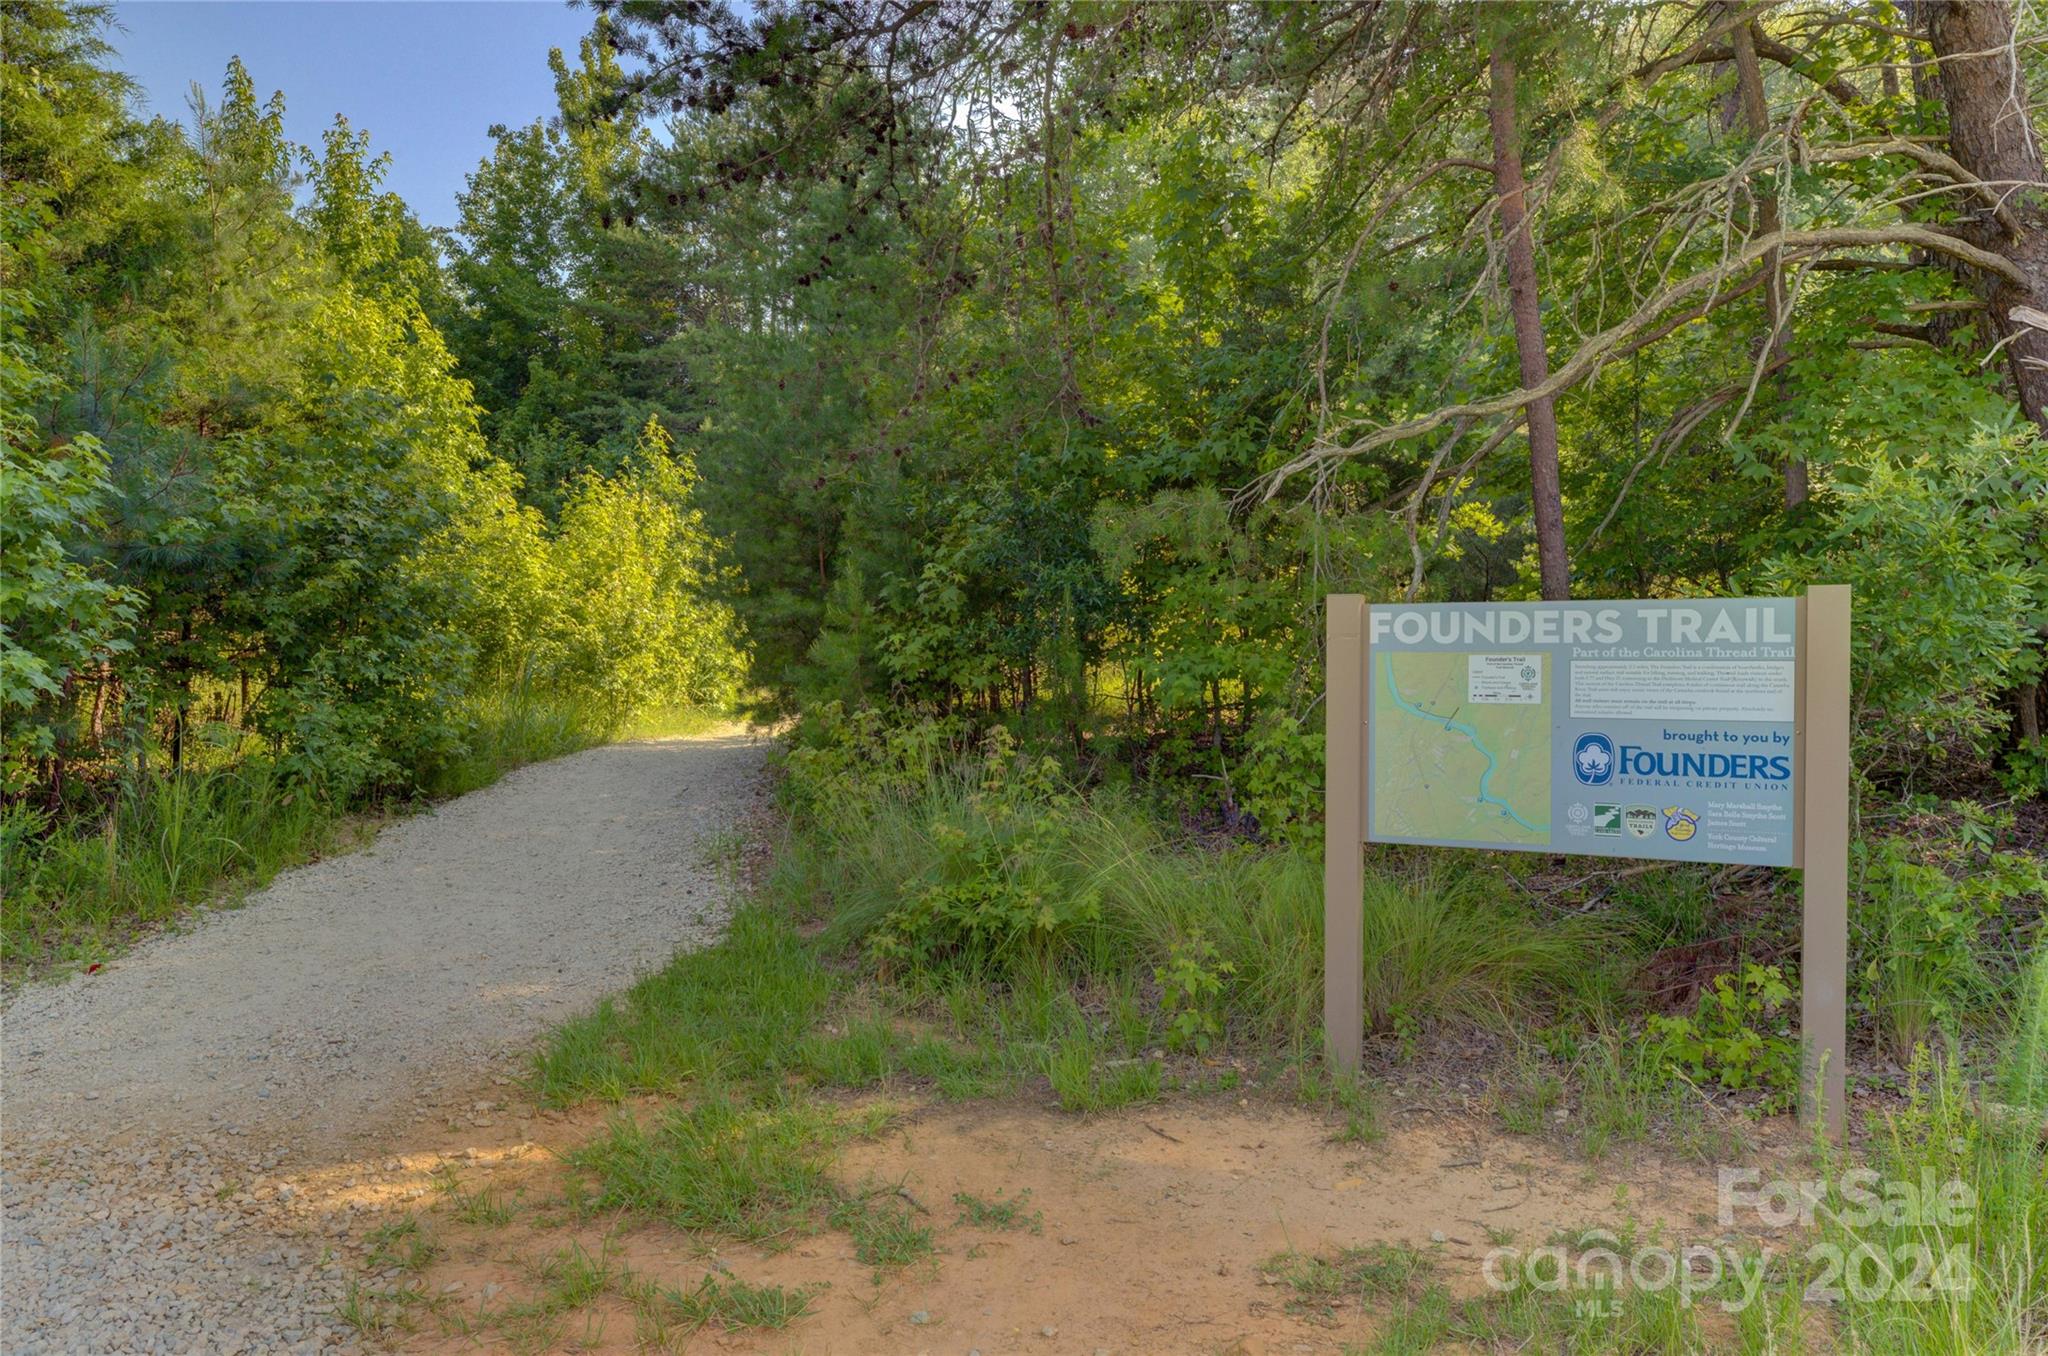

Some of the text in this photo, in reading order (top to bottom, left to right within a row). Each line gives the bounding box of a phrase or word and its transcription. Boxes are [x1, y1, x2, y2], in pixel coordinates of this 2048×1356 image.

[1370, 607, 1791, 645] FOUNDERS TRAIL
[1572, 647, 1796, 658] Part of the Carolina Thread Trail
[1663, 729, 1790, 746] brought to you by
[1619, 745, 1791, 780] FOUNDERS
[1620, 778, 1789, 792] FEDERAL CREDIT UNION
[1708, 801, 1725, 811] Mary
